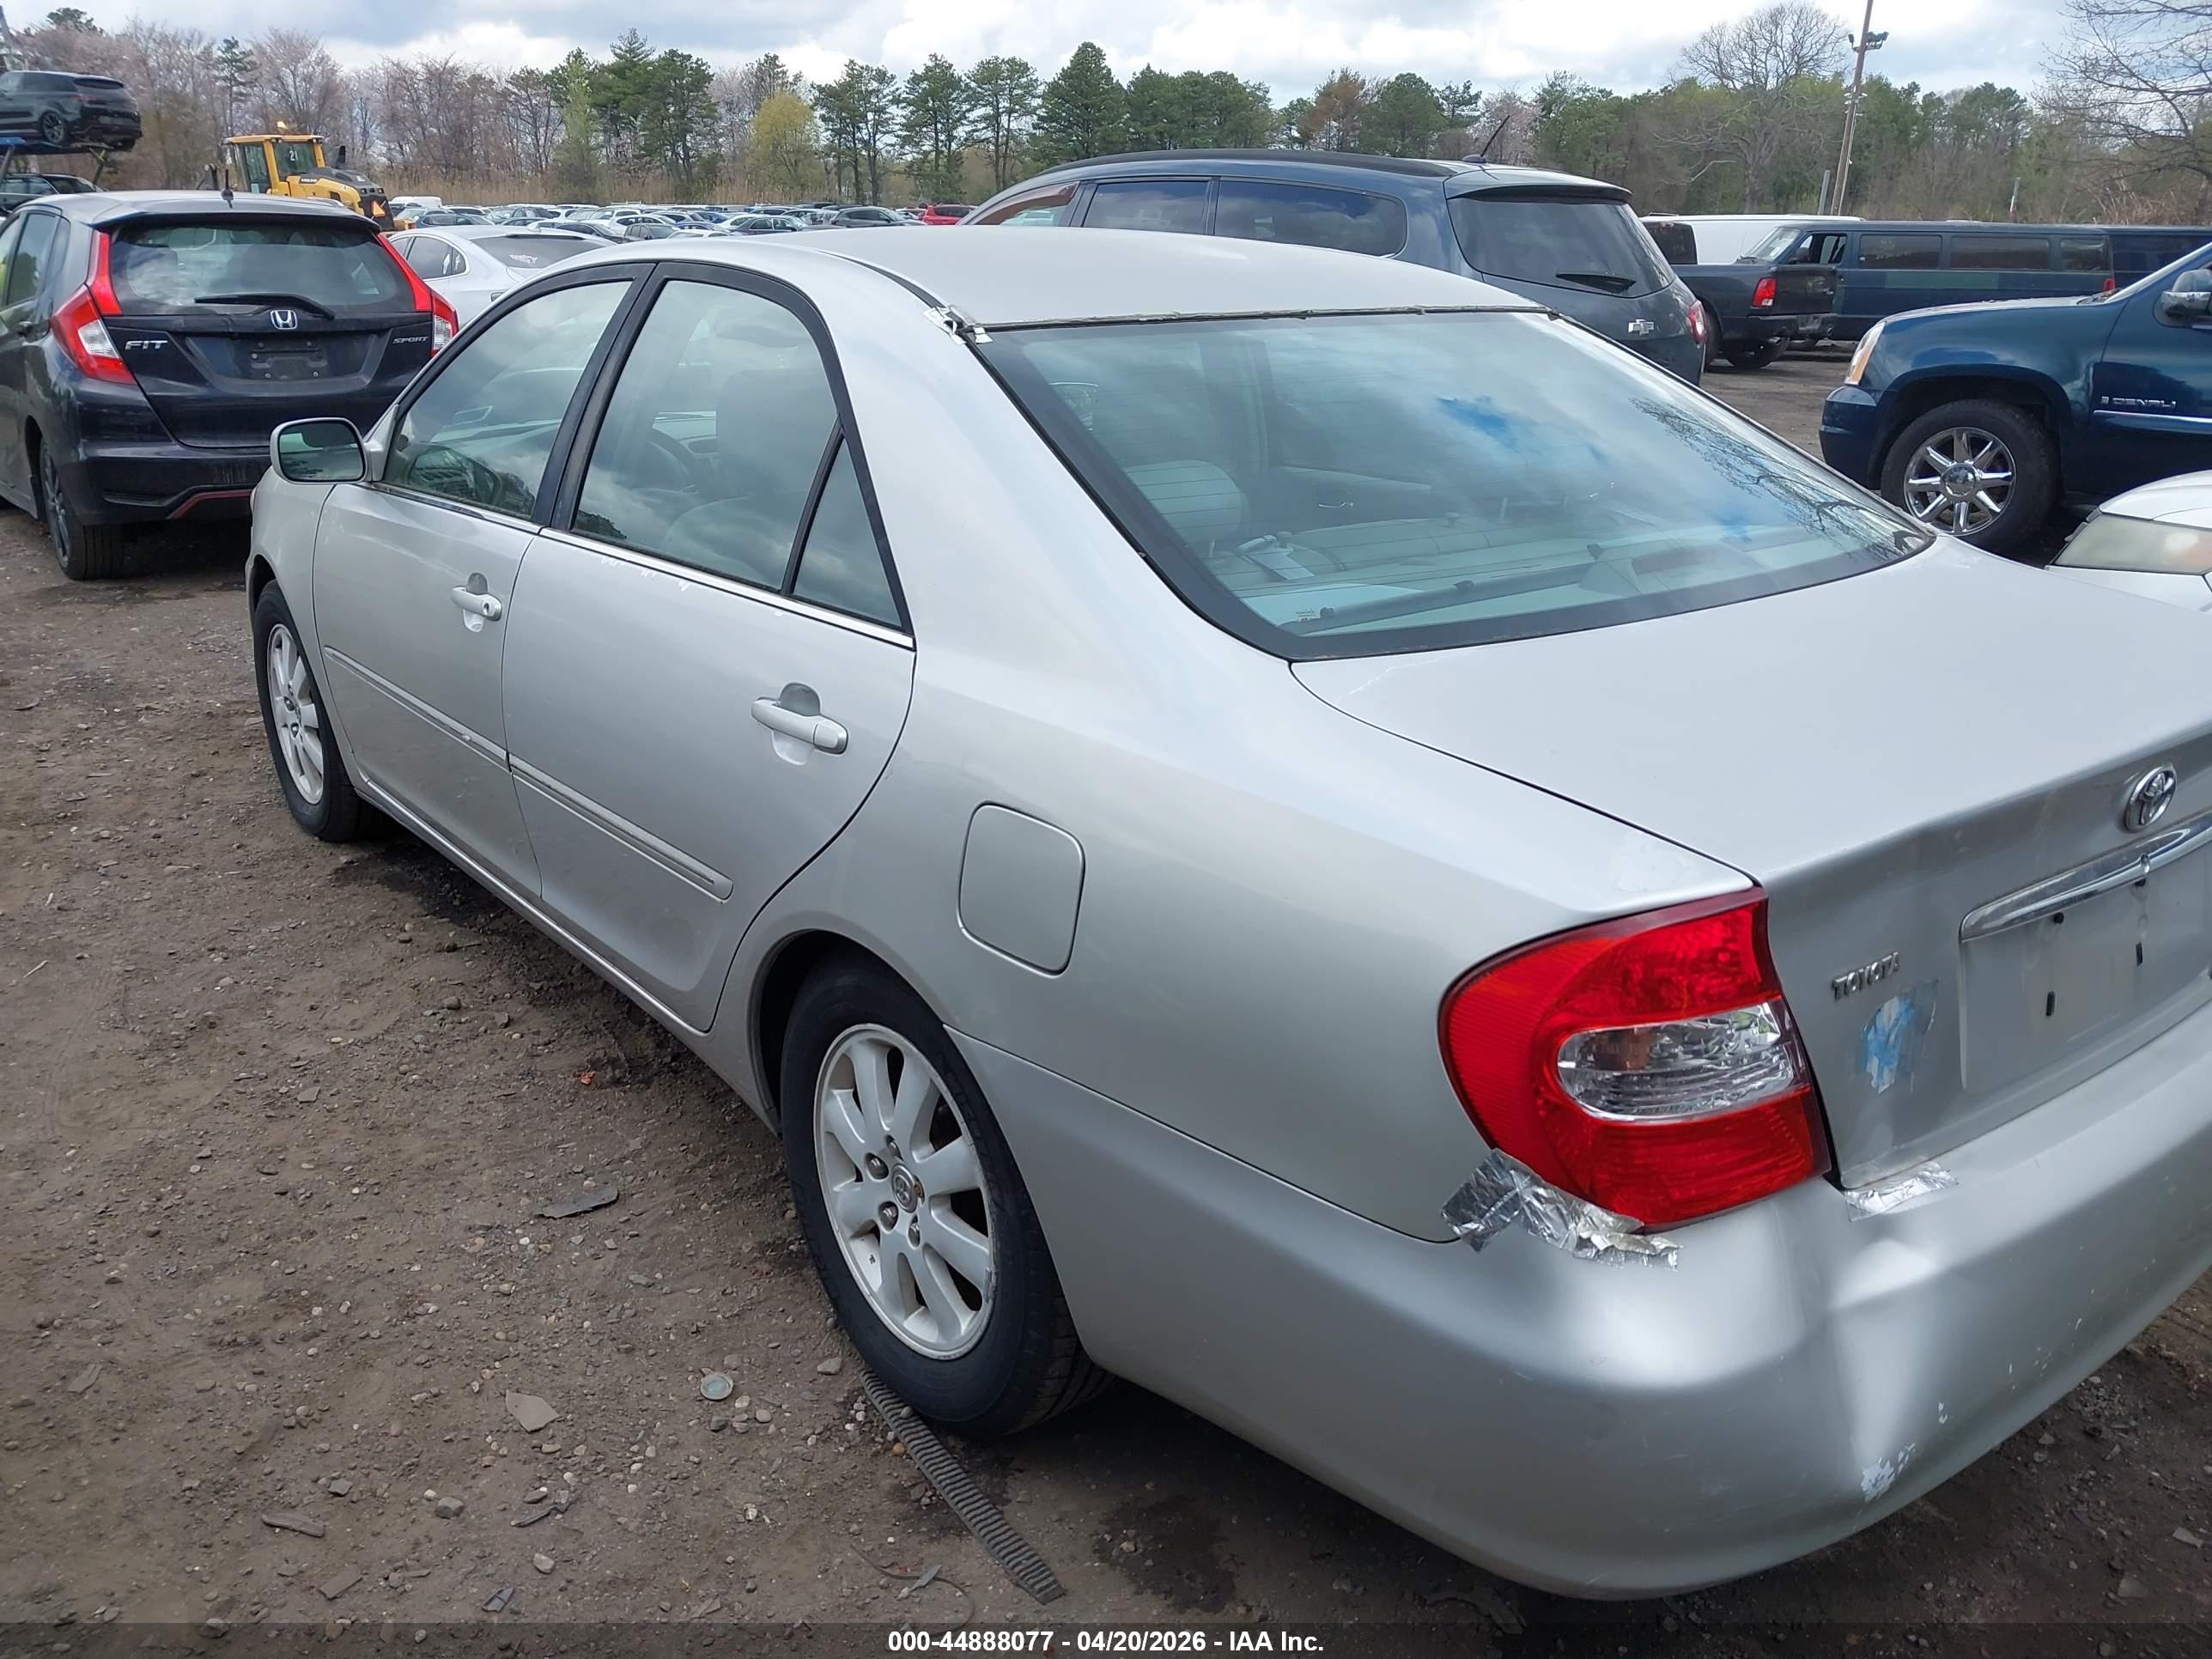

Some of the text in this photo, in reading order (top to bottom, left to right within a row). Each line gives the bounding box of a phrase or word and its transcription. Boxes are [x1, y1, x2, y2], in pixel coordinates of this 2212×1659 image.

[392, 335, 429, 344] SPORT
[125, 340, 168, 350] FIT
[2112, 398, 2176, 407] DENALI
[1832, 951, 1900, 1001] TOYOTA
